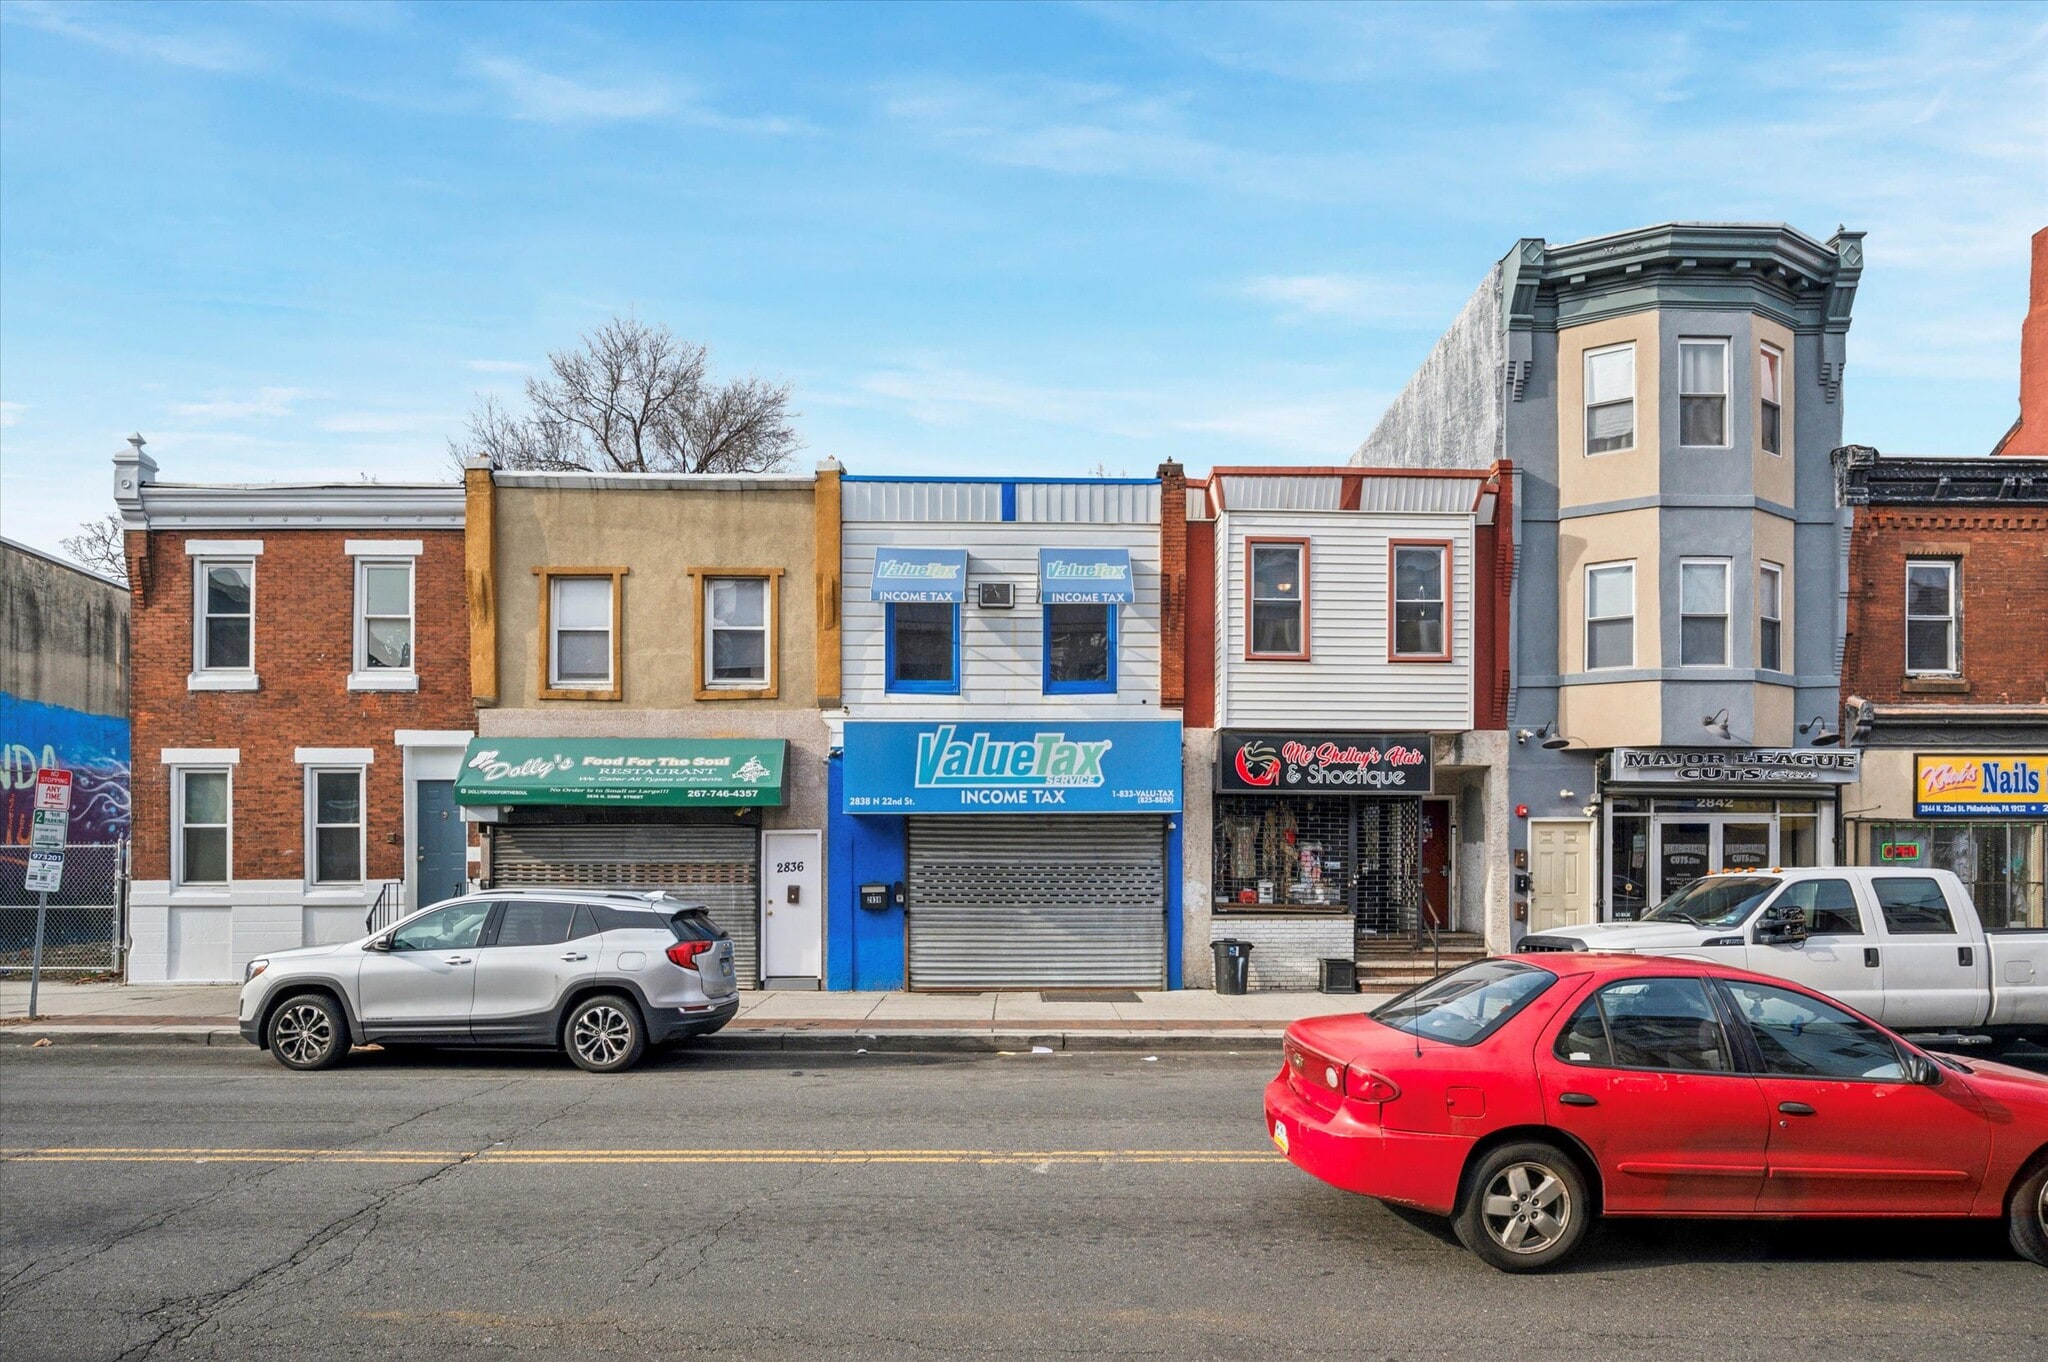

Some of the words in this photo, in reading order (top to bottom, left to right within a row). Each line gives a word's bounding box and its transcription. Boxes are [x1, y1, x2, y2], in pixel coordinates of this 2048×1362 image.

[877, 560, 961, 579] ValueTax
[1046, 561, 1128, 579] ValueTax
[880, 591, 927, 601] INCOME
[930, 592, 953, 601] TAX
[1052, 592, 1098, 602] INCOME
[1101, 592, 1125, 602] TAX
[582, 756, 625, 766] Food
[626, 757, 656, 766] For
[657, 757, 690, 766] The
[692, 757, 731, 766] Soul
[916, 725, 1108, 788] ValueTax
[1384, 745, 1424, 767] Hair
[1625, 752, 1725, 767] MAJOR
[1735, 753, 1857, 769] LEAGUE
[484, 753, 574, 781] Dolly's
[1286, 764, 1301, 784] &
[1678, 767, 1761, 780] CUTS
[1982, 762, 2040, 794] Nails
[41, 777, 69, 785] STOPPING
[645, 776, 674, 784] Types
[1046, 776, 1094, 786] SERVICE
[45, 793, 62, 801] TIME
[687, 789, 758, 798] 267-746-4357
[961, 790, 1028, 804] INCOME
[1032, 790, 1066, 804] TAX
[1112, 789, 1174, 798] 1-833-VALU-TAX
[849, 797, 871, 806] 2838
[872, 797, 880, 805] N
[881, 797, 902, 806] 22nd
[904, 797, 916, 806] St.
[1696, 799, 1734, 808] 2842
[1943, 804, 1957, 812] 22nd
[36, 811, 43, 823] 2
[1884, 845, 1917, 858] OPEN
[776, 861, 804, 873] 2836
